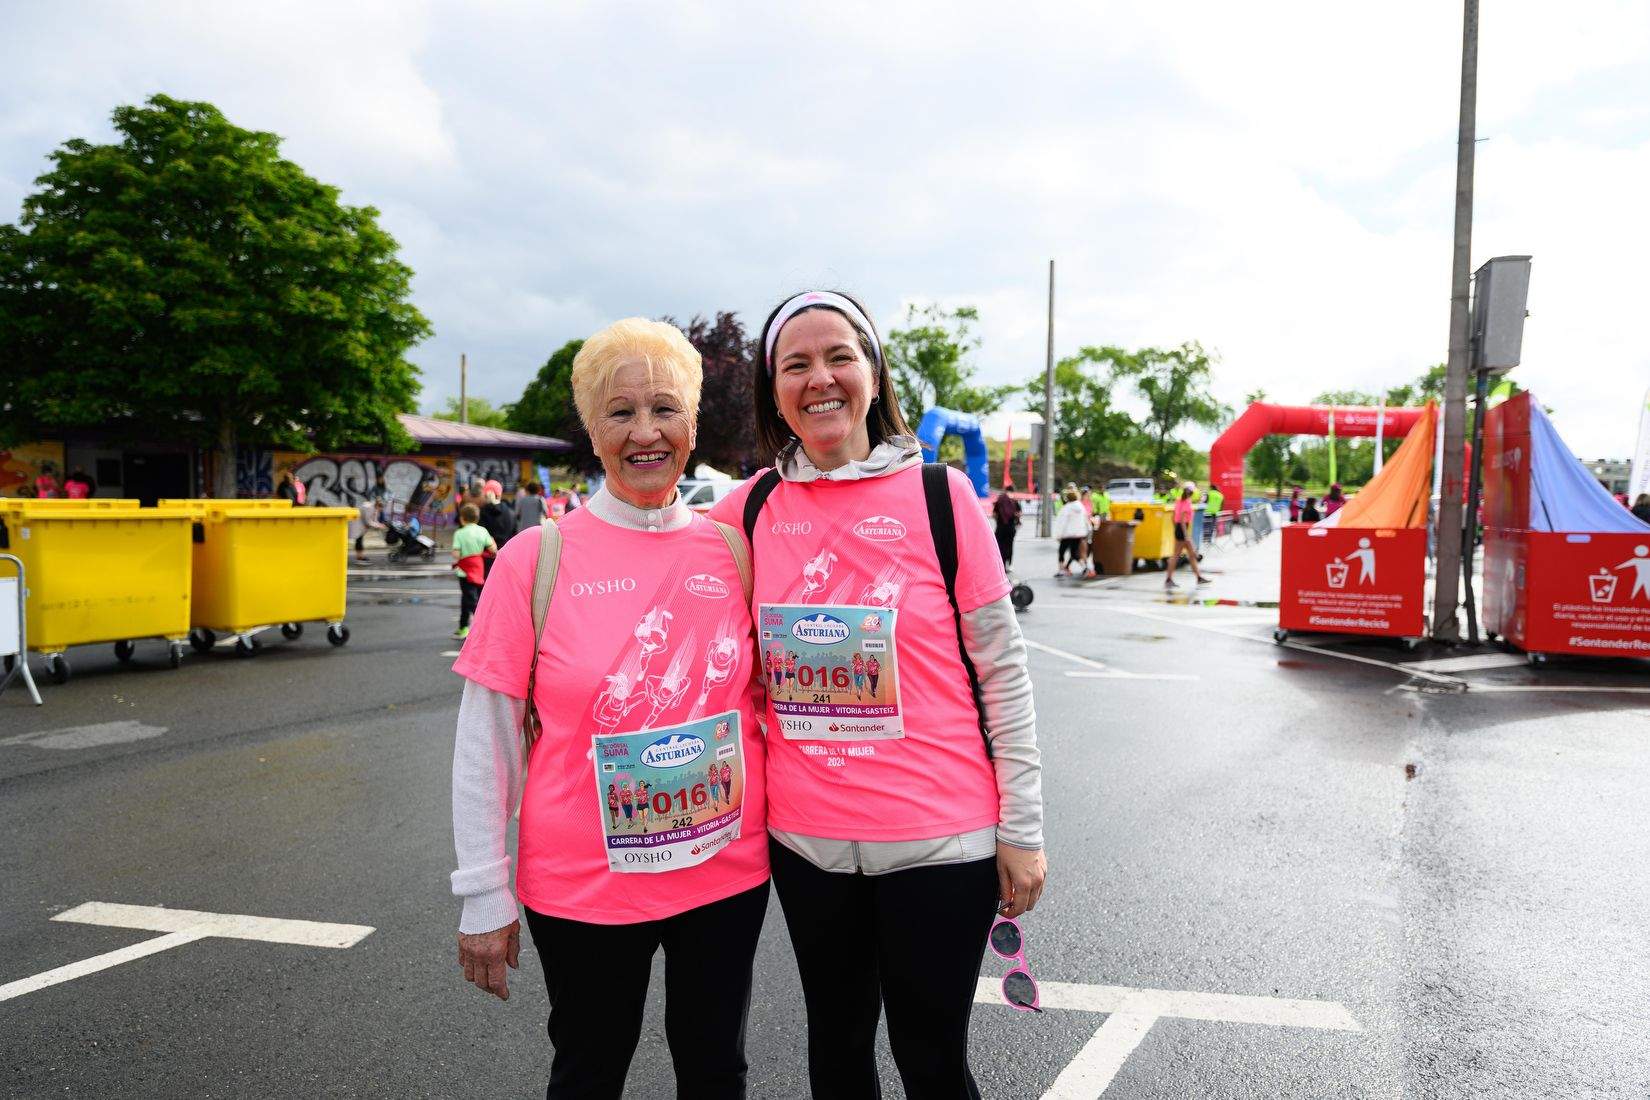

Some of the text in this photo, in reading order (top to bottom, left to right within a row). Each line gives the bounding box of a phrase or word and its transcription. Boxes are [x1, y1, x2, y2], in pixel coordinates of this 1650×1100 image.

[571, 577, 636, 597] OYSHO
[796, 625, 846, 638] ASTURIANA
[798, 665, 850, 688] 016
[812, 694, 831, 703] 241
[789, 704, 797, 712] DE
[798, 705, 807, 713] LA
[808, 705, 830, 714] MUJER
[836, 706, 895, 715] VITORIA-GASTEIZ
[779, 720, 812, 731] YSHO
[840, 724, 885, 733] Santander
[603, 748, 629, 757] SUMA
[645, 744, 702, 764] ASTURIANA
[848, 745, 875, 756] MUJER
[827, 757, 846, 767] 2024
[652, 783, 708, 815] 016
[672, 817, 693, 829] 242
[611, 836, 643, 846] CARRERA
[644, 836, 654, 844] DE
[656, 834, 665, 842] LA
[666, 829, 692, 841] MUJER
[624, 850, 672, 864] OYSHO
